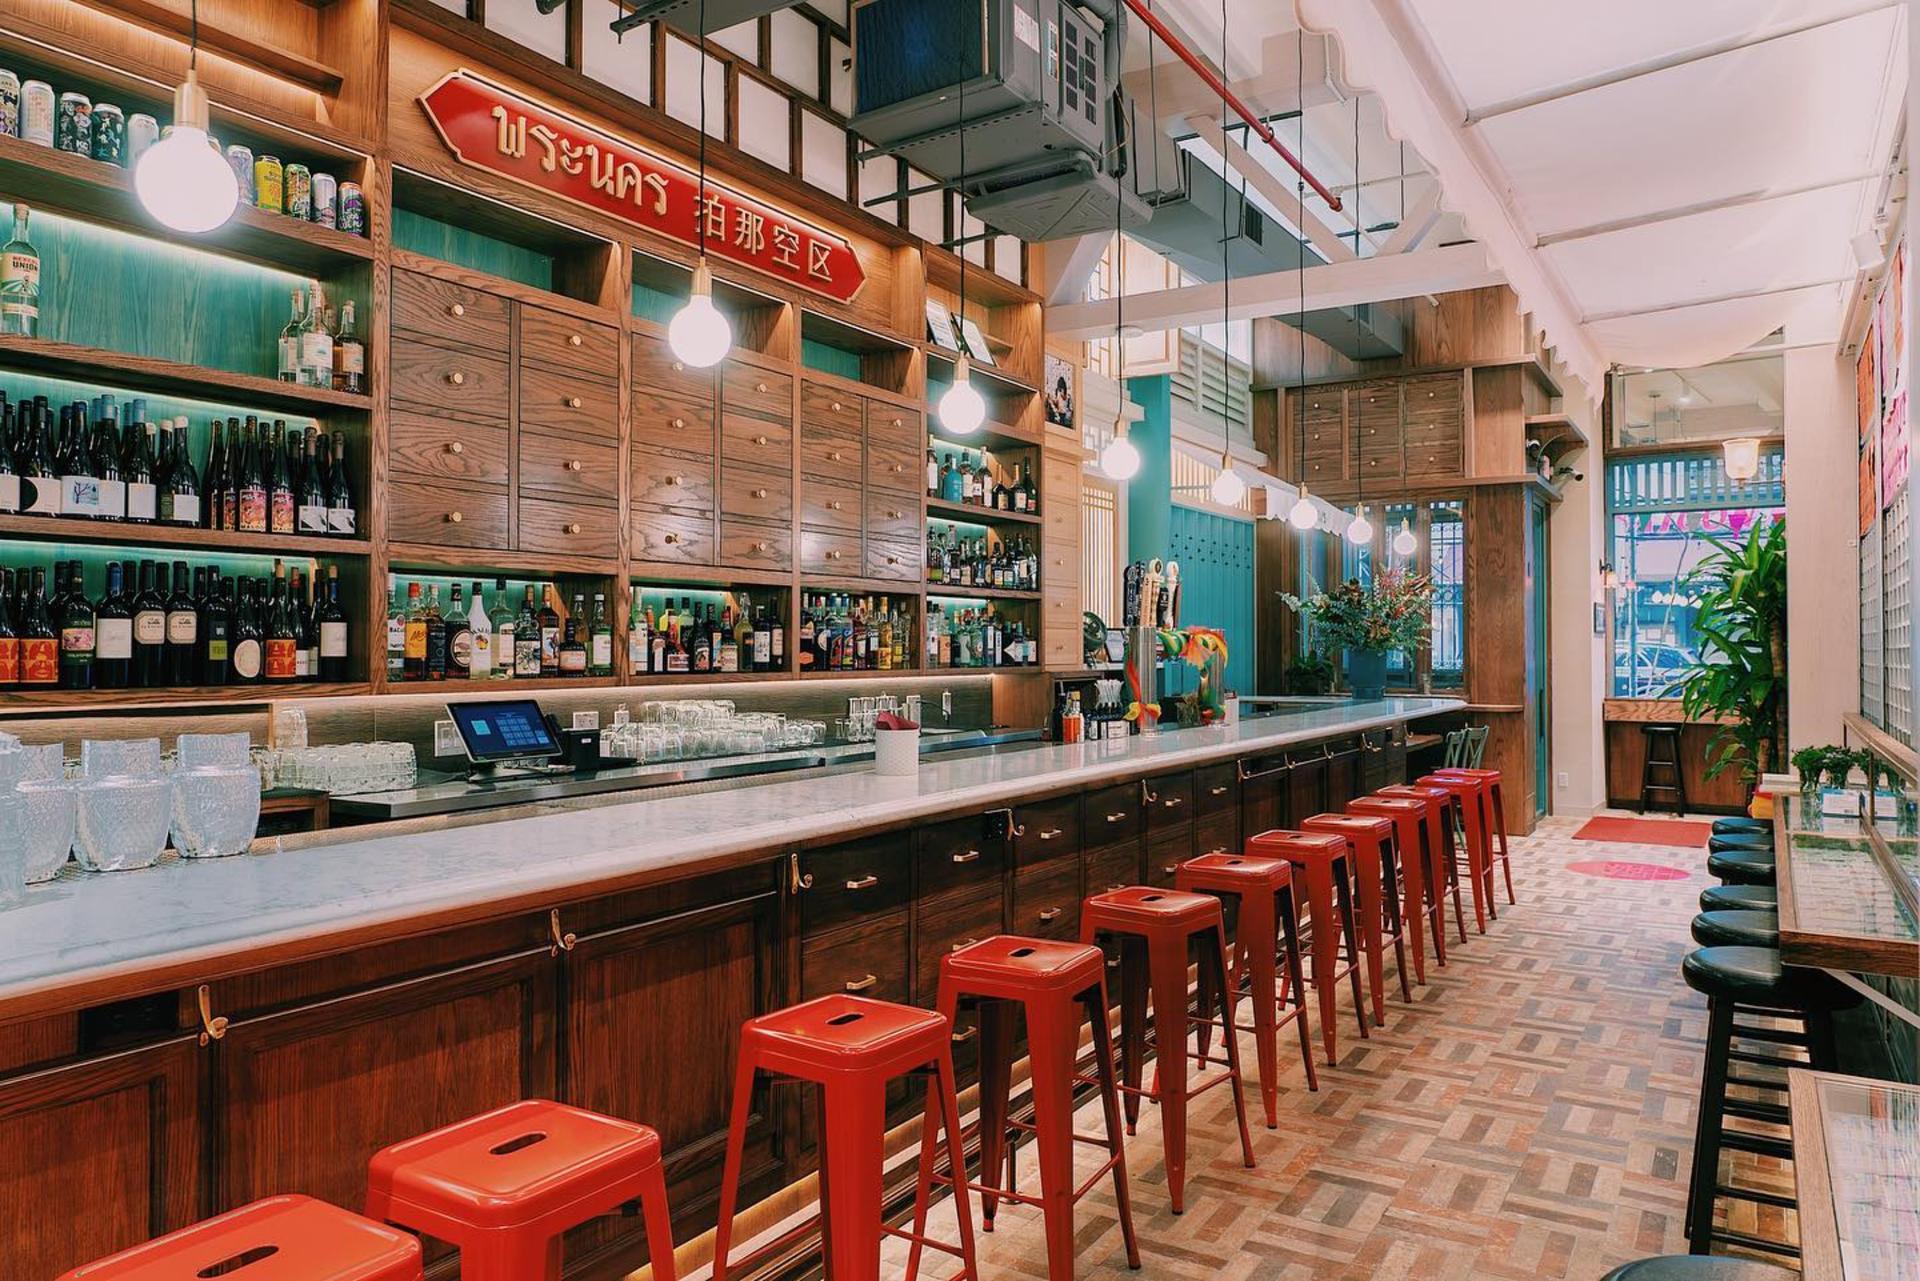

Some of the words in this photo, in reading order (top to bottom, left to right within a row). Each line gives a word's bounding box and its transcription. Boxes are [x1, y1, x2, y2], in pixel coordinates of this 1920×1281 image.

[491, 104, 670, 216] พระนคร
[12, 260, 38, 272] UNION
